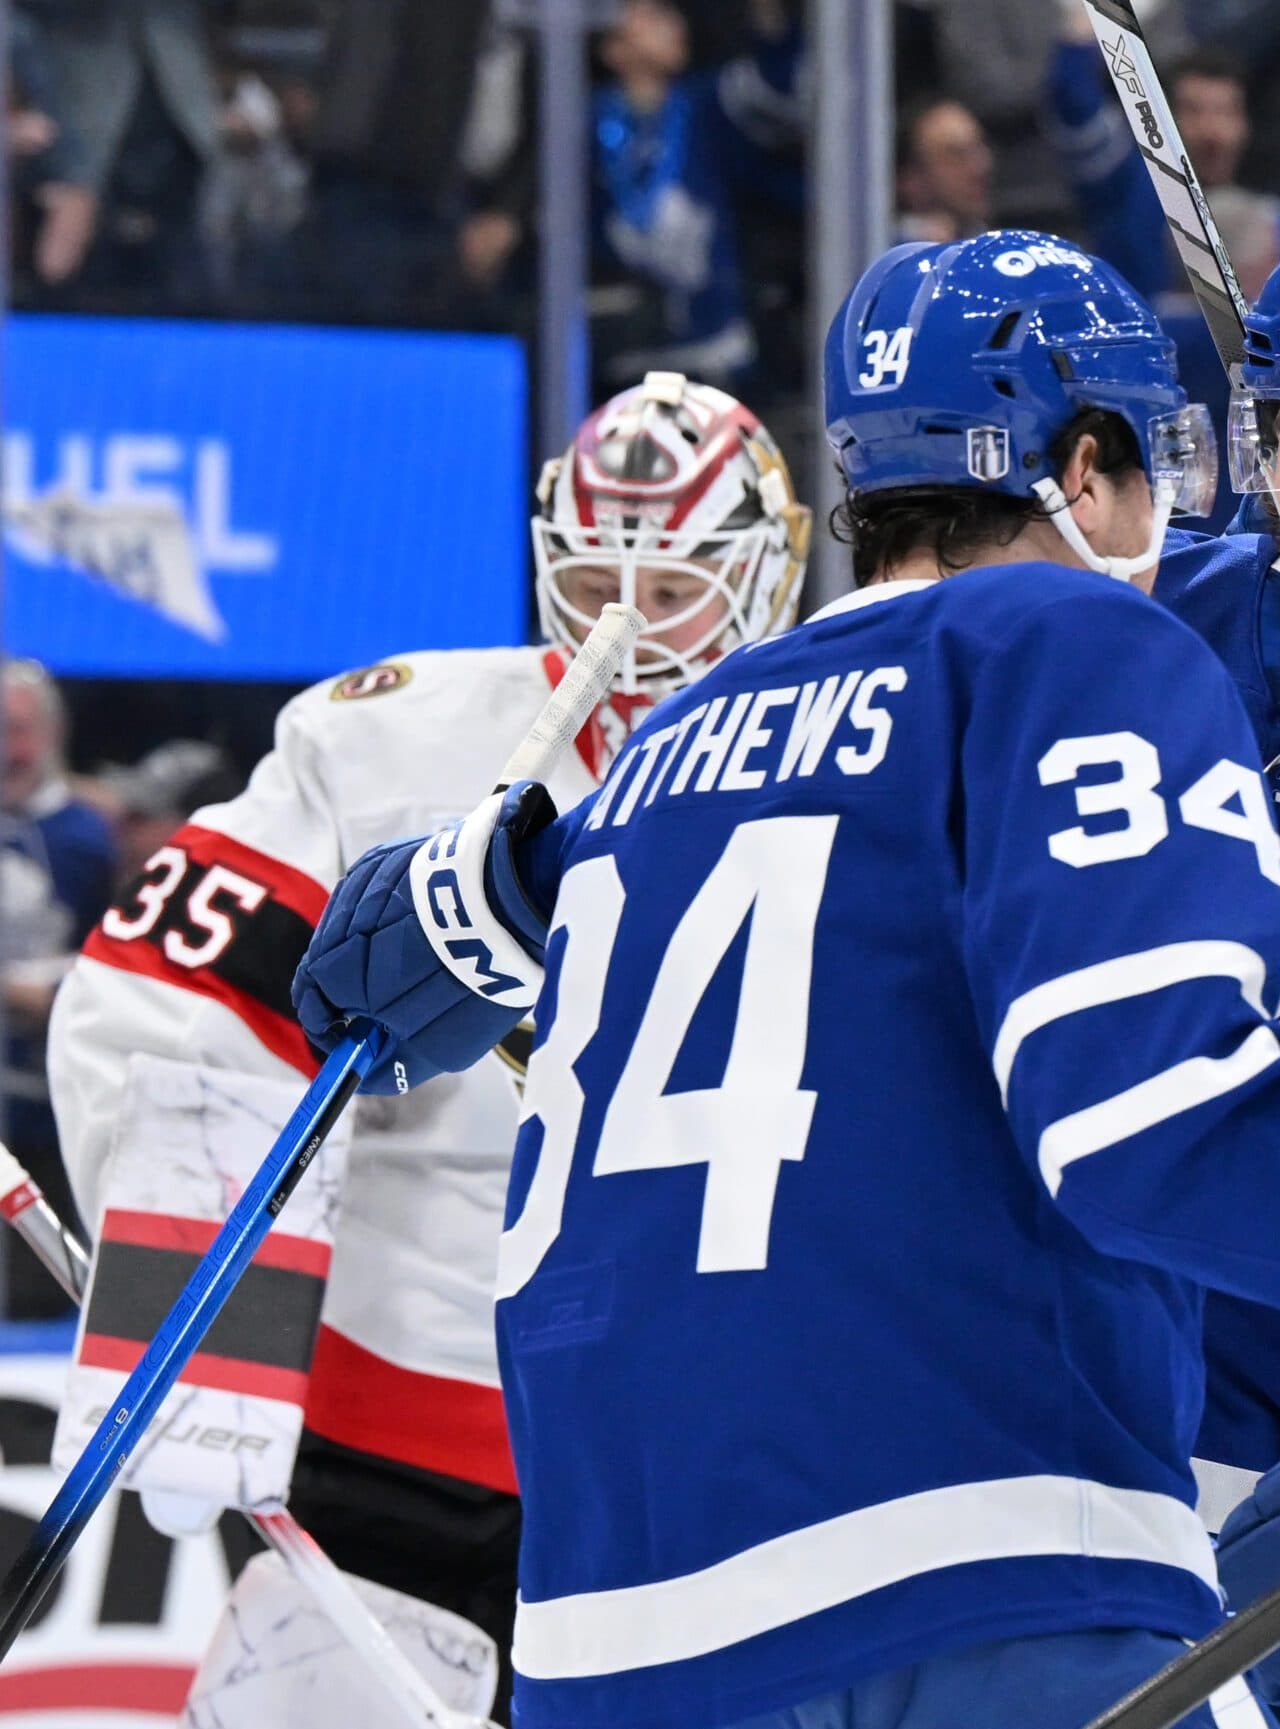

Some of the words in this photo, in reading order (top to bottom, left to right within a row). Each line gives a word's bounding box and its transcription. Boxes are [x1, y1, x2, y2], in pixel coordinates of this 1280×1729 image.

[1102, 34, 1146, 98] XF
[1135, 101, 1164, 149] PRO
[858, 327, 914, 388] 34
[101, 848, 268, 969] 35
[496, 815, 840, 1301] 34
[298, 1135, 321, 1167] KNIES
